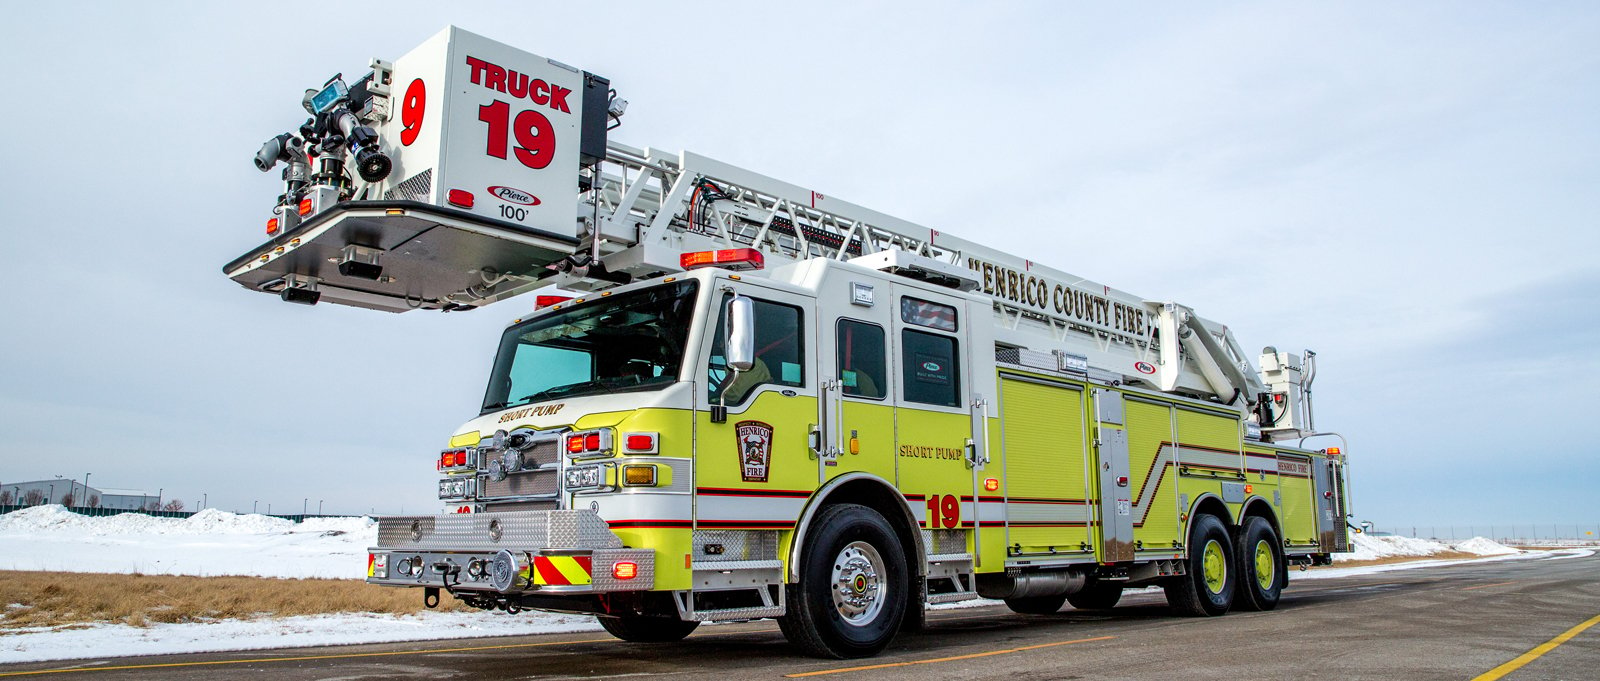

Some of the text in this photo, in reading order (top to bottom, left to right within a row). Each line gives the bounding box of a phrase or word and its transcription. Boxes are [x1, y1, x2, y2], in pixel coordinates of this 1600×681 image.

[466, 55, 573, 115] TRUCK
[478, 99, 556, 170] 19
[498, 204, 529, 222] 100'
[1053, 284, 1110, 327] COUNTY
[1113, 301, 1144, 336] FIRE
[498, 403, 565, 424] SHORT PUMP
[740, 426, 769, 438] HENRICO
[899, 444, 962, 460] SHORT PUMP
[746, 467, 763, 476] FIRE
[927, 493, 960, 529] 19
